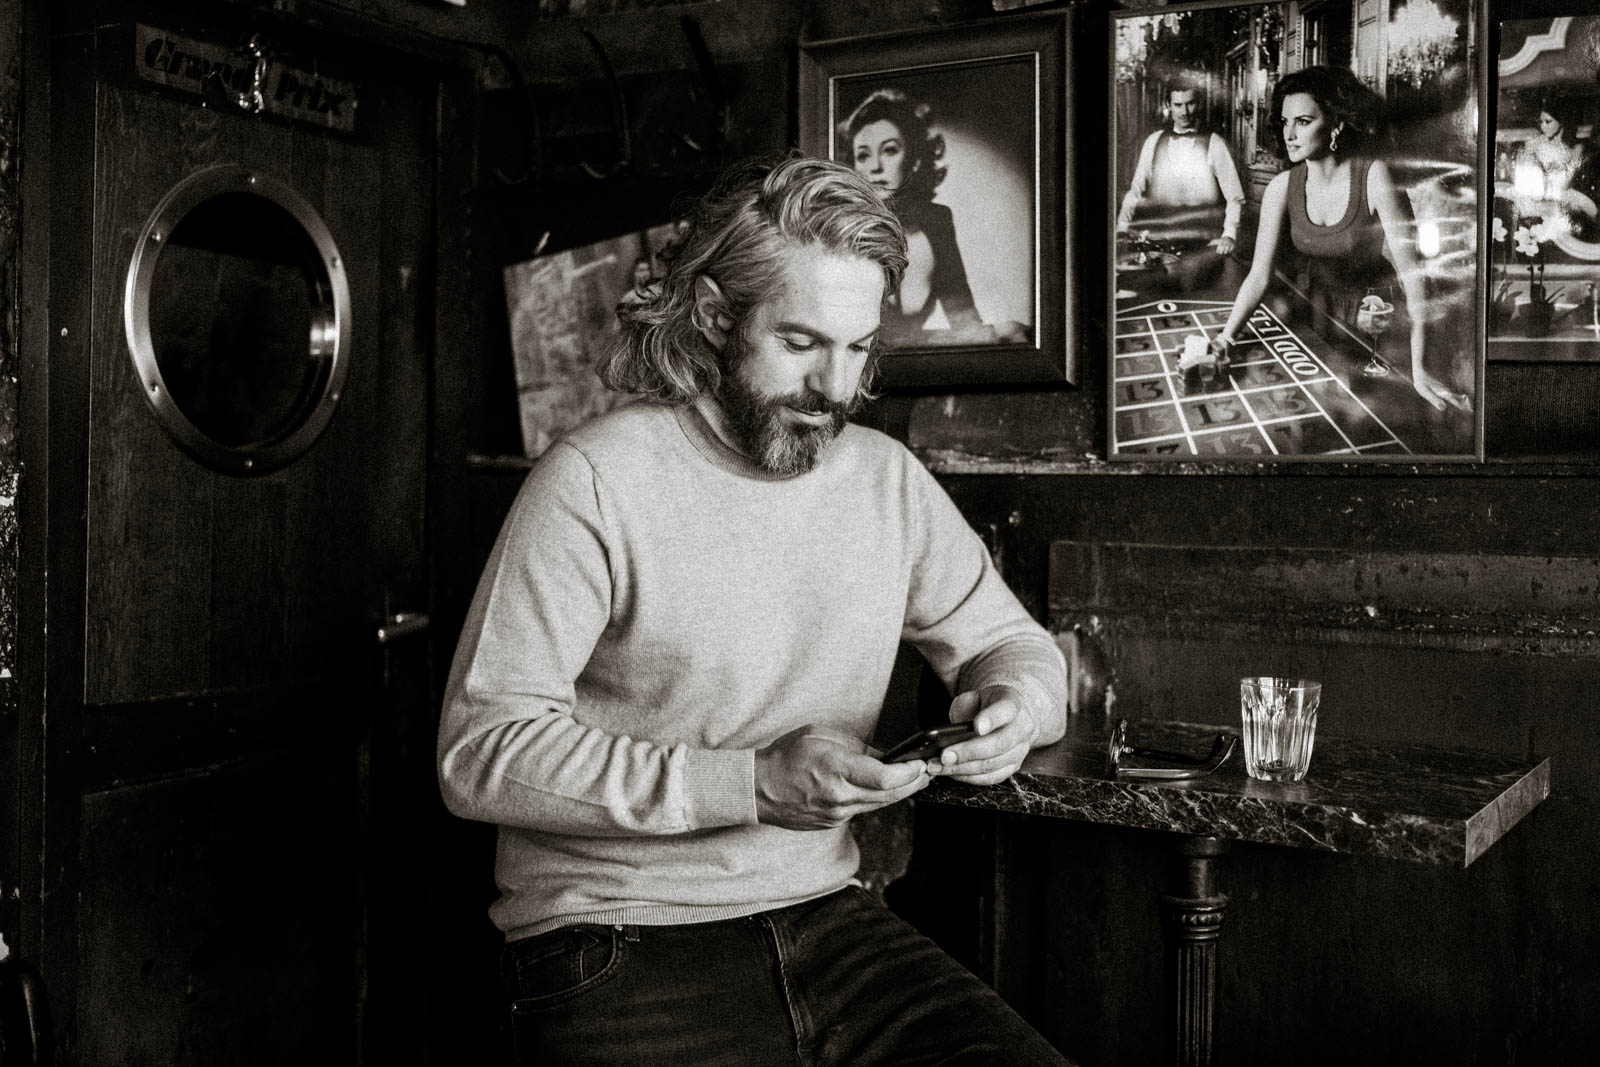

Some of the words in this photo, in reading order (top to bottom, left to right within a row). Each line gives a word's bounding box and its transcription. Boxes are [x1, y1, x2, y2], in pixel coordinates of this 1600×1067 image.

[144, 39, 257, 92] Grand
[275, 71, 346, 116] Prix
[1273, 341, 1320, 375] ODD
[1122, 380, 1163, 402] 13
[1192, 399, 1243, 425] 13
